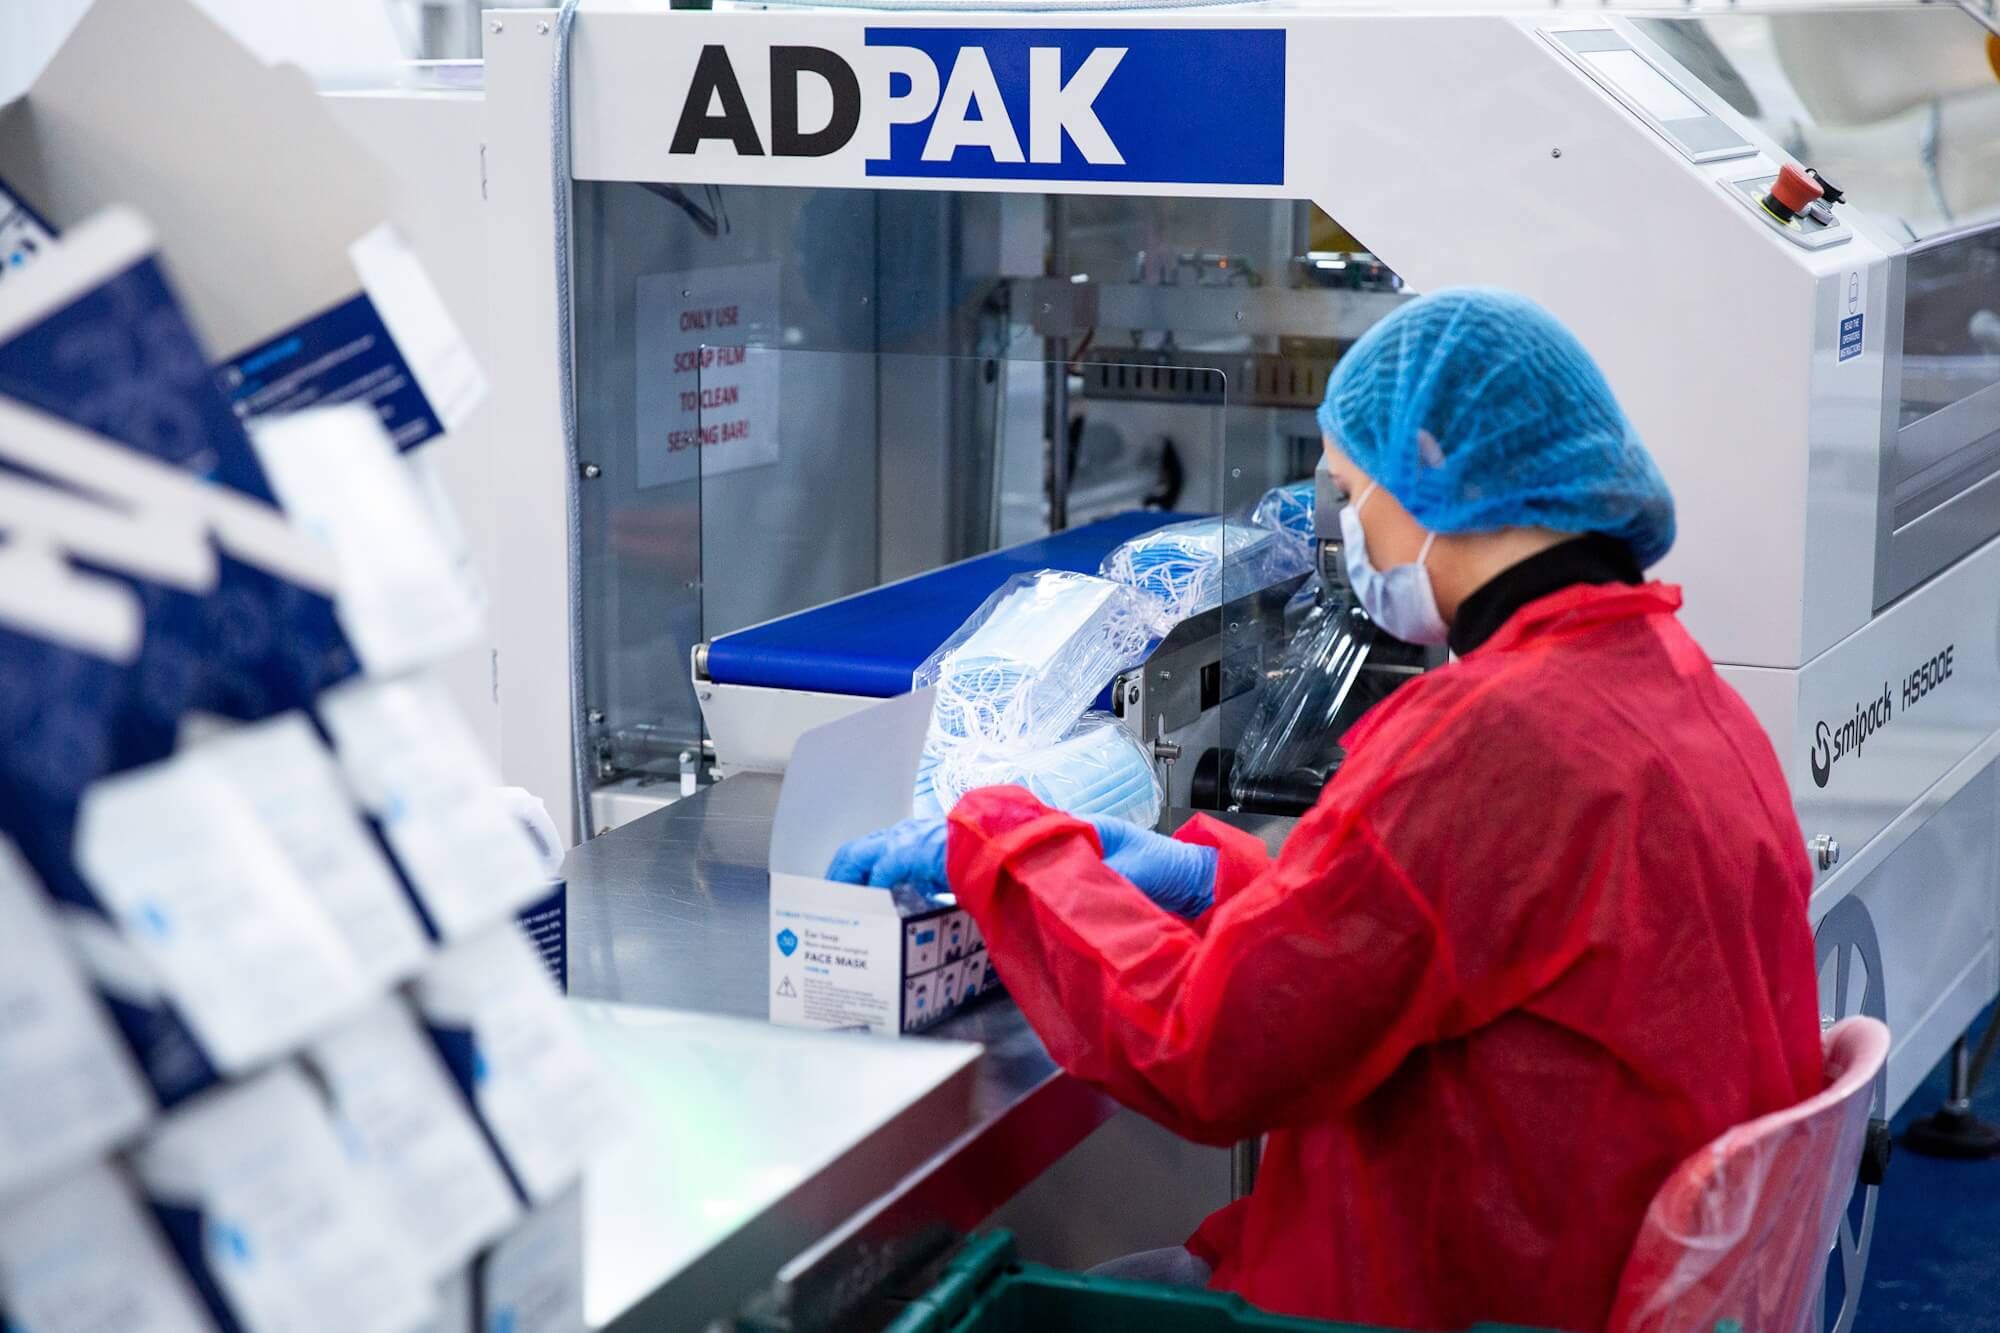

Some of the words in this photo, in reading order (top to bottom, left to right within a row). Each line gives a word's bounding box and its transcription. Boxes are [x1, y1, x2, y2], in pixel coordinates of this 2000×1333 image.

[668, 44, 1129, 165] ADPAK
[680, 308, 712, 332] ONLY
[716, 305, 738, 327] USE
[673, 348, 713, 374] SCRAP
[717, 344, 746, 368] FILM
[680, 391, 697, 411] TO
[701, 386, 739, 409] CLEAN
[1833, 681, 1892, 763] smipack
[1902, 643, 1954, 712] HS500E
[804, 951, 832, 966] FACE
[835, 956, 868, 970] MASK
